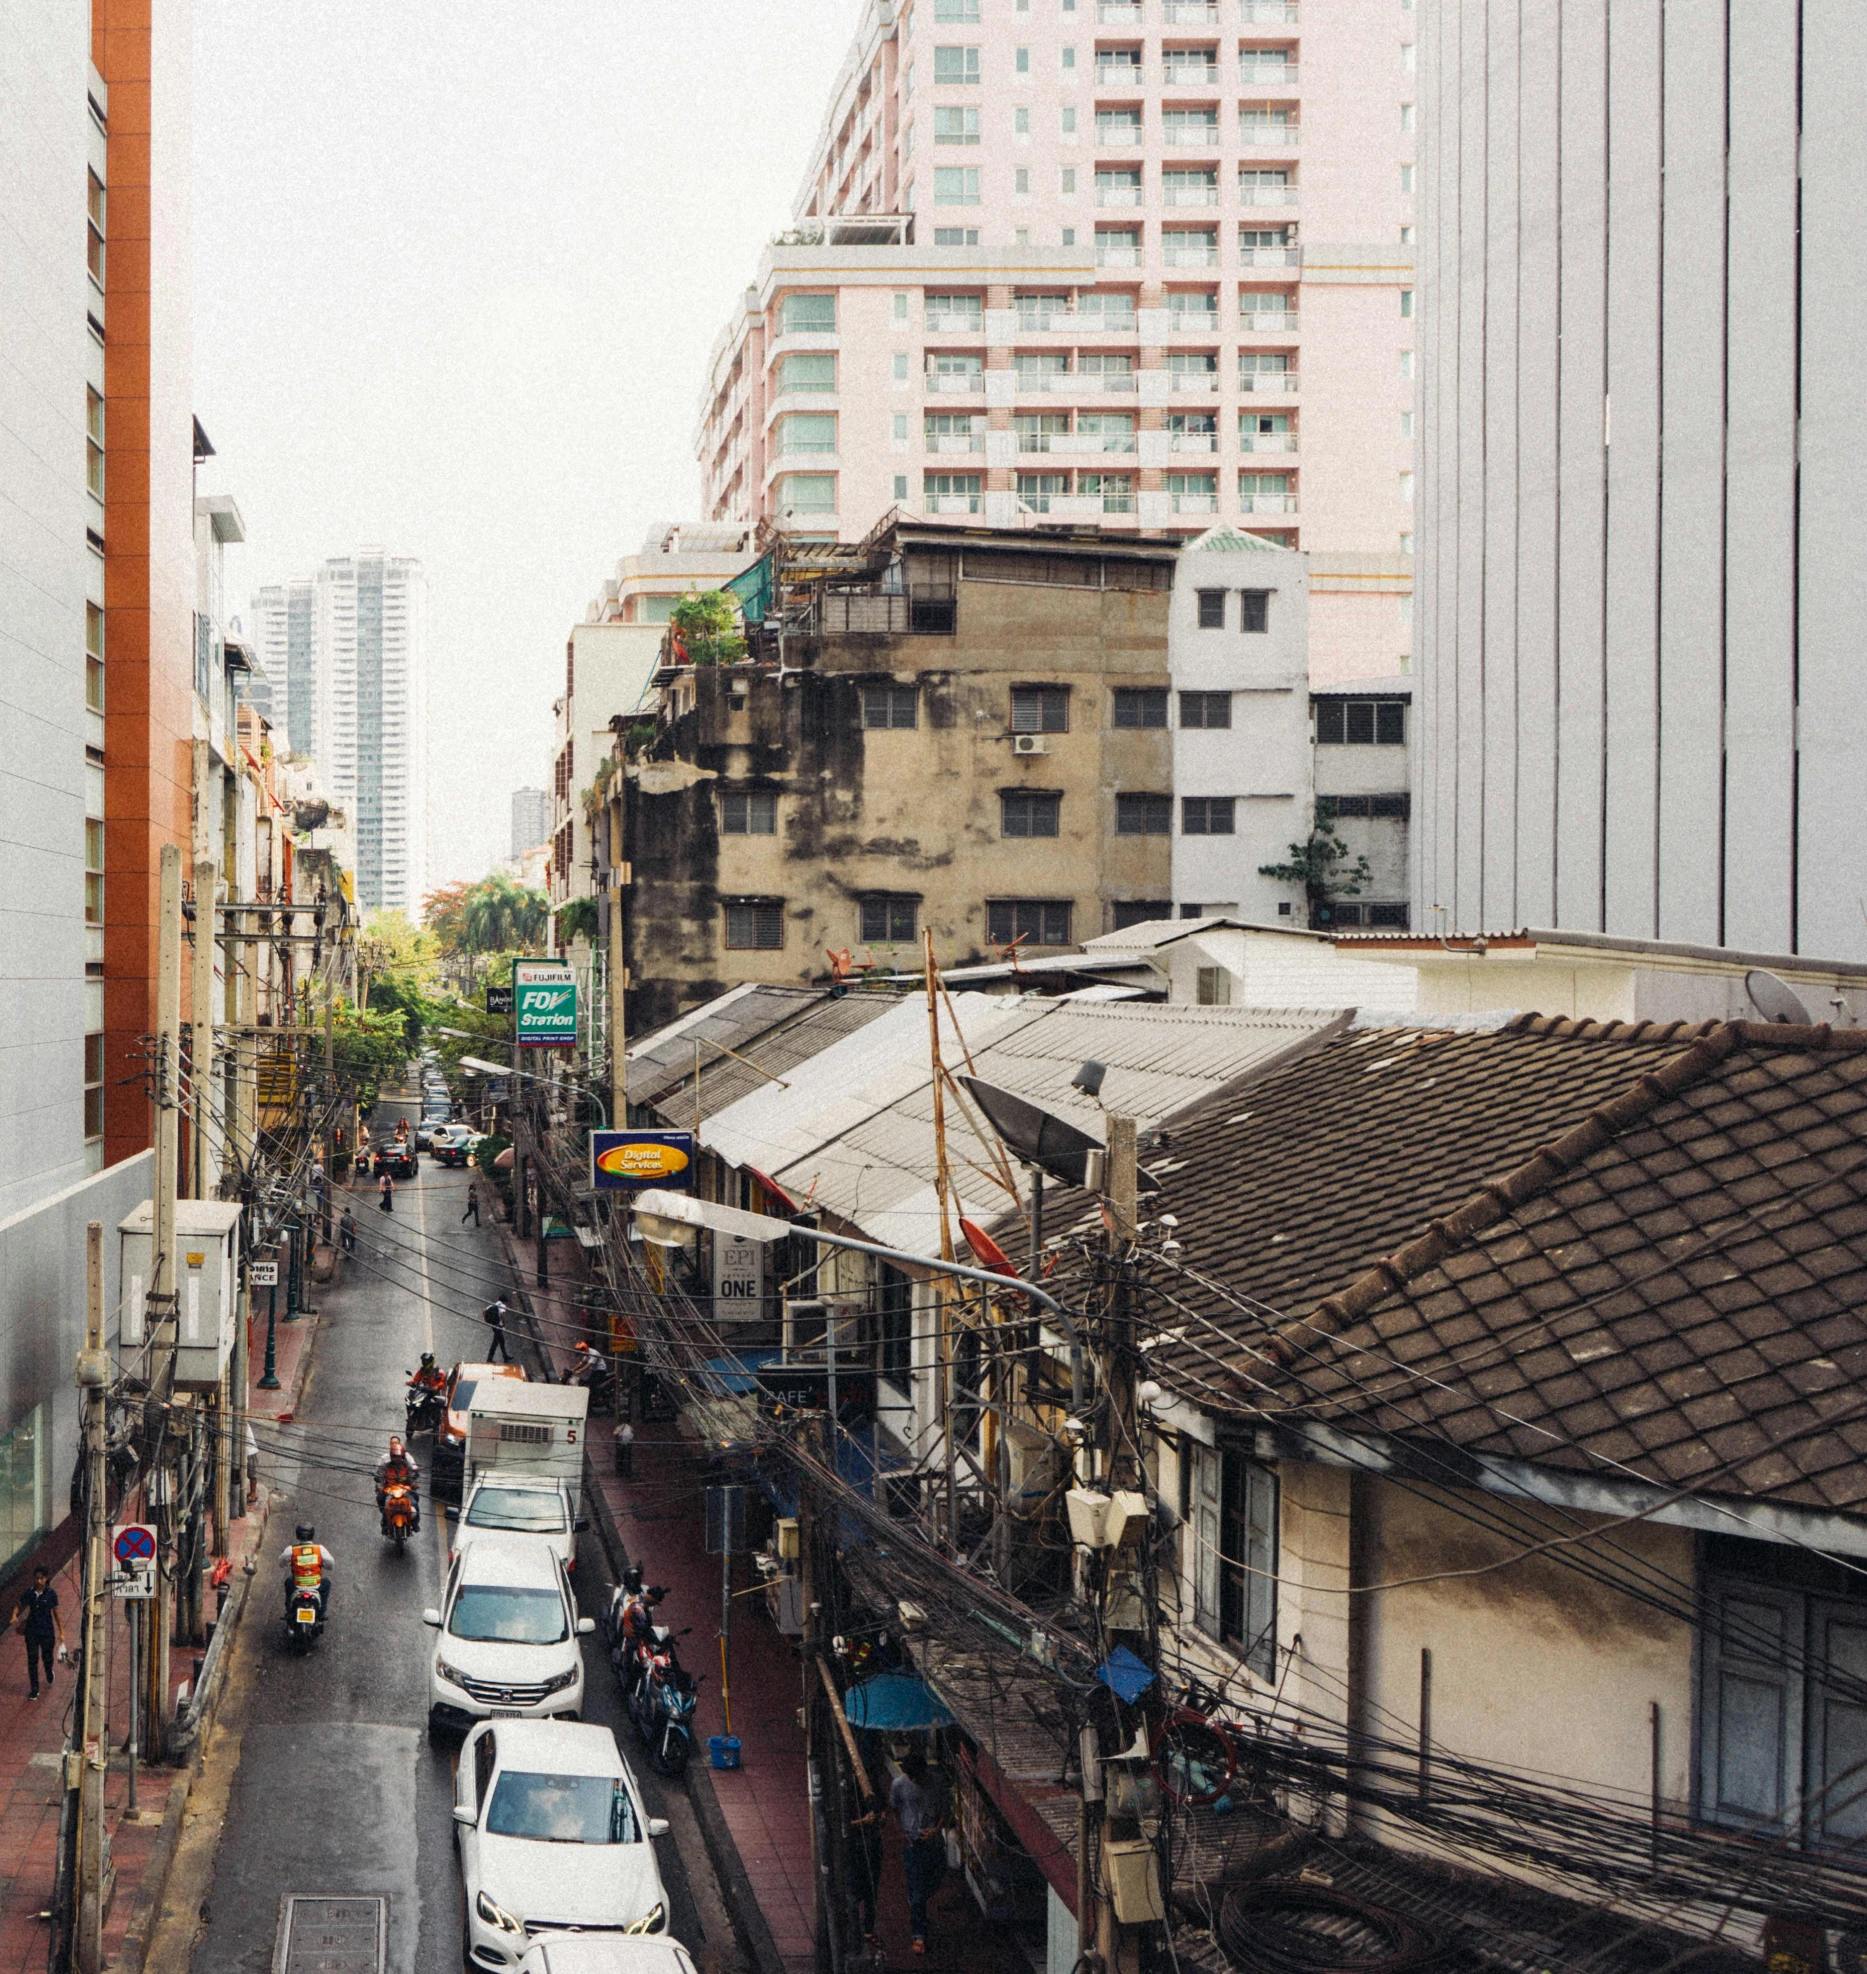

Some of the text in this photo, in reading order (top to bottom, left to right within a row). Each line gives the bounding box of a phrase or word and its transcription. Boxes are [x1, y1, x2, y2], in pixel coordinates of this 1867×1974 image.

[533, 973, 572, 981] FUJIFILM
[624, 1149, 662, 1161] Digital
[620, 1160, 664, 1170] Services
[723, 1250, 755, 1266] EPI
[721, 1280, 756, 1297] ONE
[566, 1430, 577, 1445] 5
